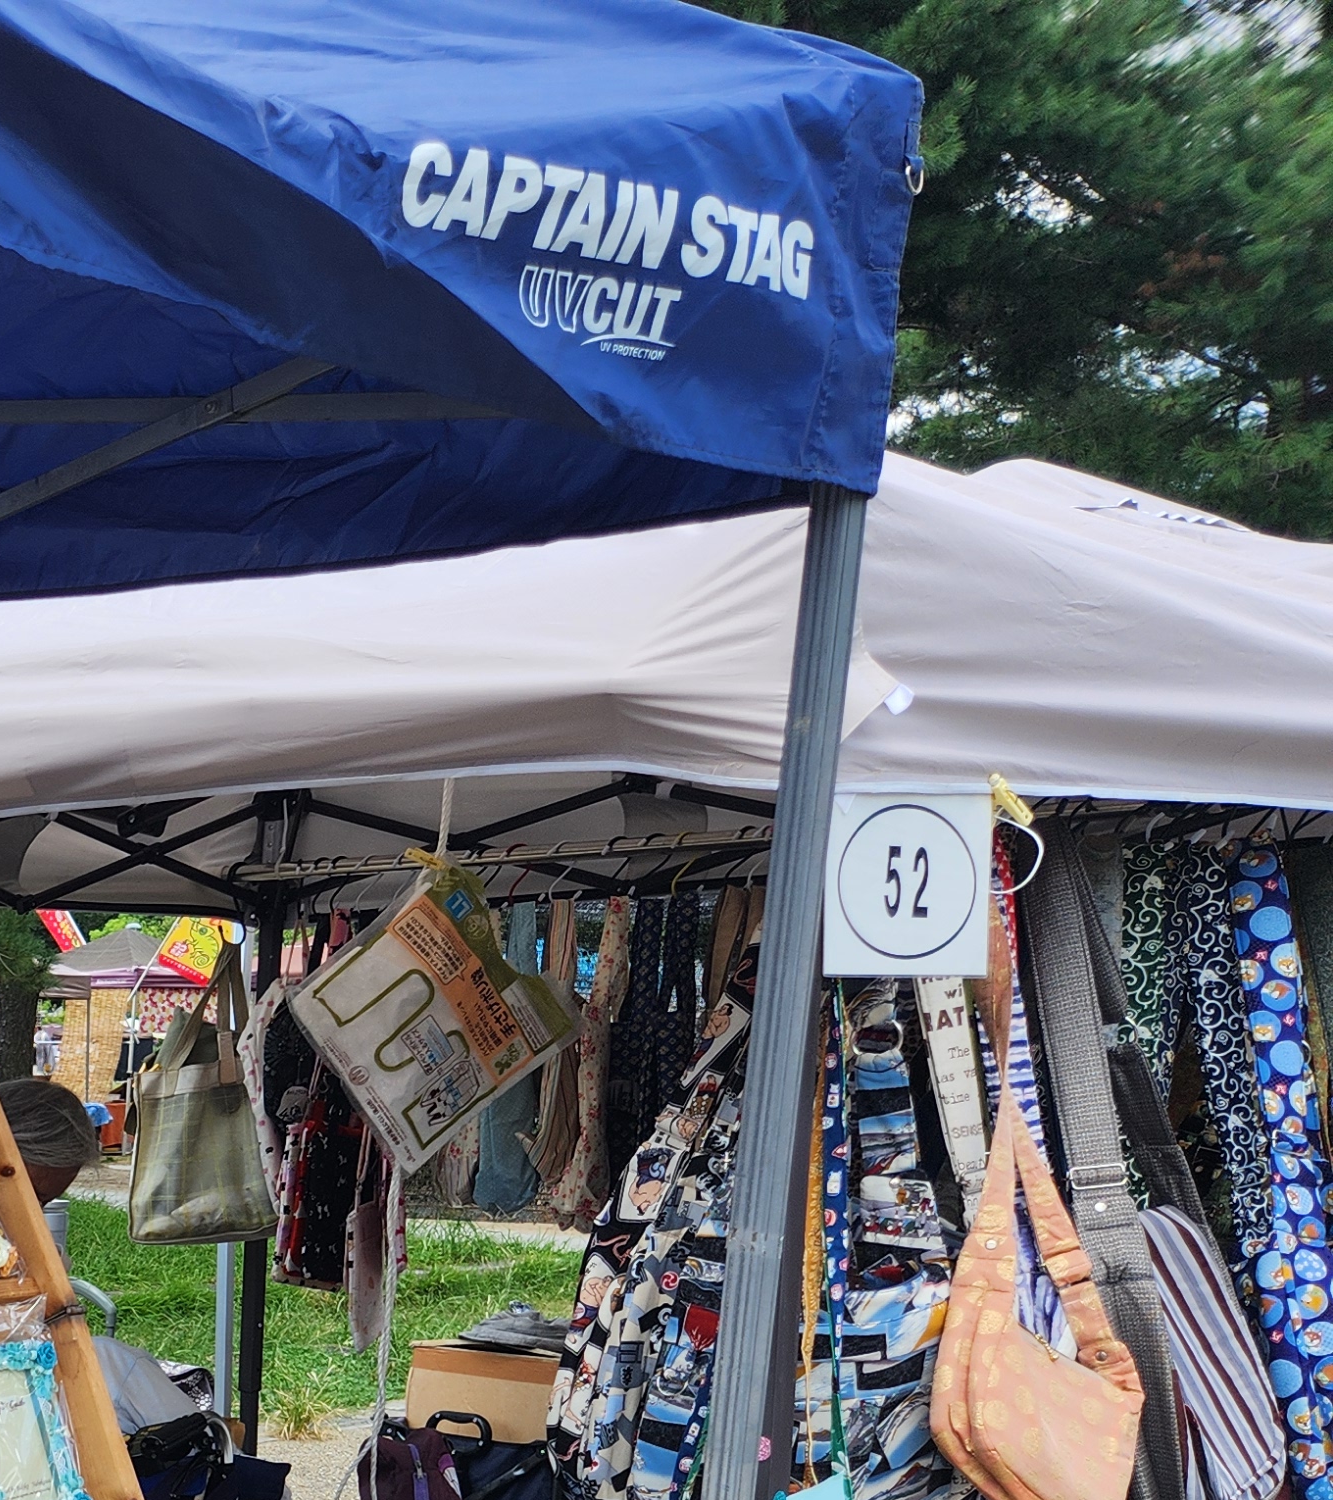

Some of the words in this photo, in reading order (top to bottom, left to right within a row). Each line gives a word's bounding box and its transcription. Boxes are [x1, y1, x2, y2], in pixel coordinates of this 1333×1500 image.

[402, 142, 679, 270] CAPTAIN
[681, 195, 814, 300] STAG
[612, 345, 666, 361] PROTECTION
[883, 845, 929, 918] 52
[470, 967, 519, 1038] 手さげポリ袋
[948, 1046, 970, 1060] The
